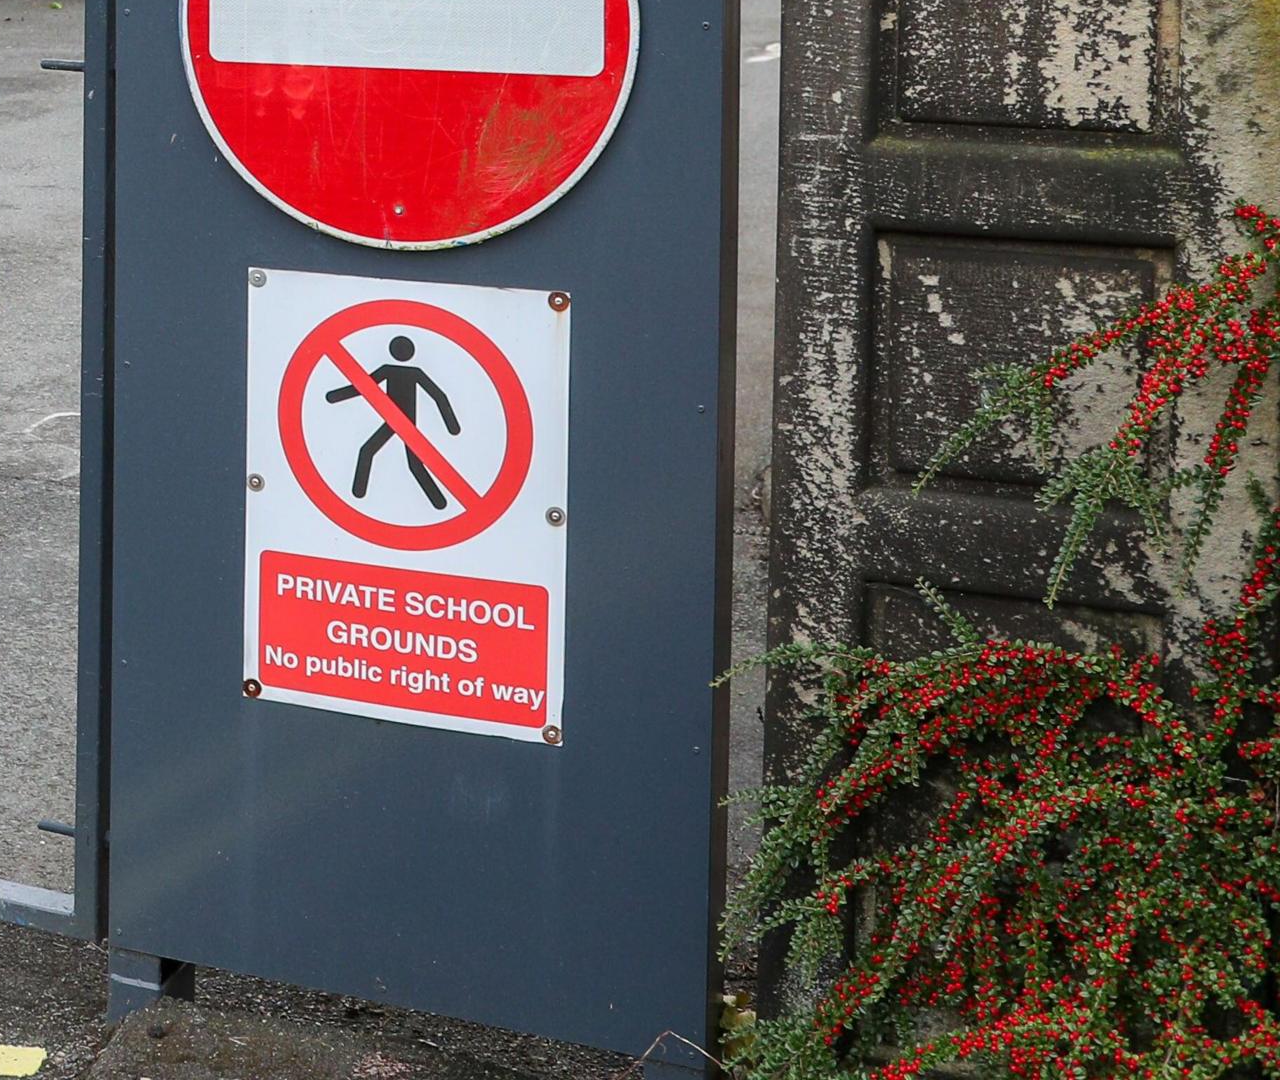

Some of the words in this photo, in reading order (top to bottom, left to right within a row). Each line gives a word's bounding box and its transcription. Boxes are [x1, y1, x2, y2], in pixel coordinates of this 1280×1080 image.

[277, 573, 396, 612] PRIVATE
[404, 591, 535, 630] SCHOOL
[326, 621, 478, 663] GROUNDS
[265, 645, 298, 669] No
[306, 653, 382, 683] public
[390, 666, 450, 694] right
[458, 676, 484, 697] of
[492, 683, 545, 711] way
